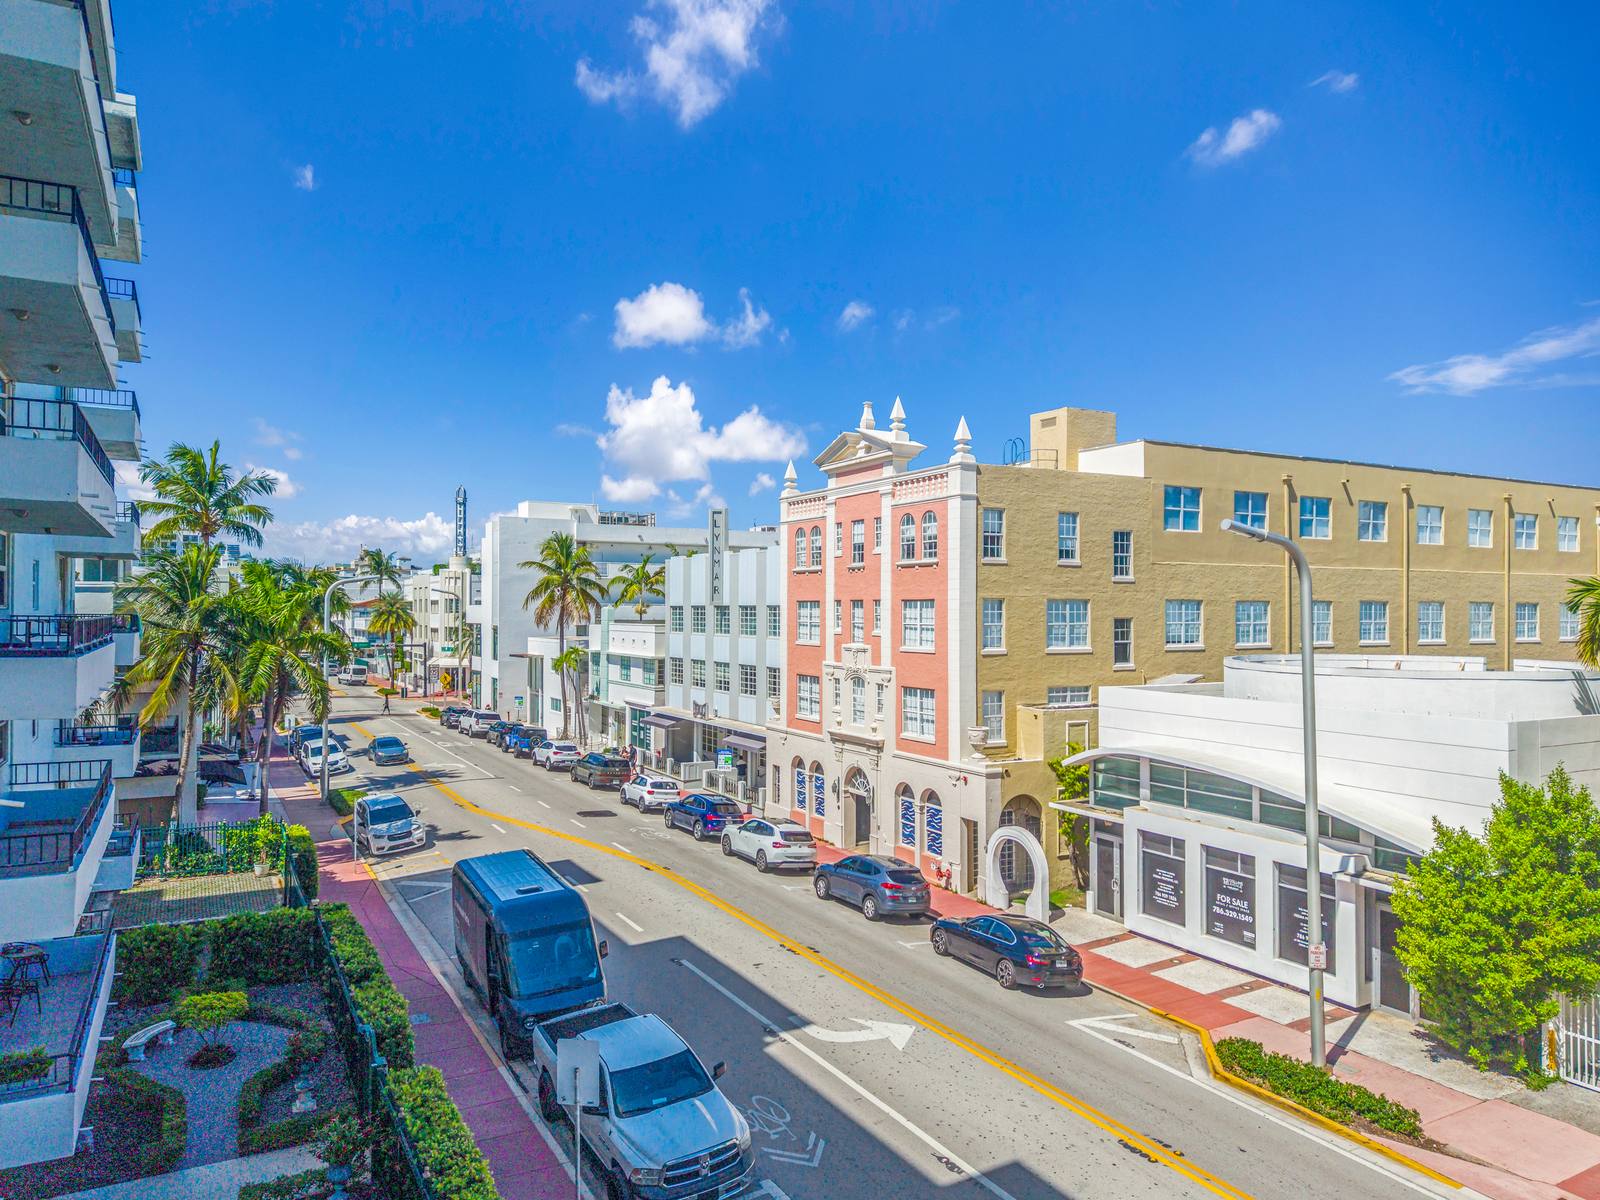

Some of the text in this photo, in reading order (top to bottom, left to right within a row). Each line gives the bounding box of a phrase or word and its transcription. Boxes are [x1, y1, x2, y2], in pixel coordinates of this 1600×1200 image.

[1216, 894, 1249, 909] FOR SALE
[1212, 906, 1253, 923] 786.329.1549
